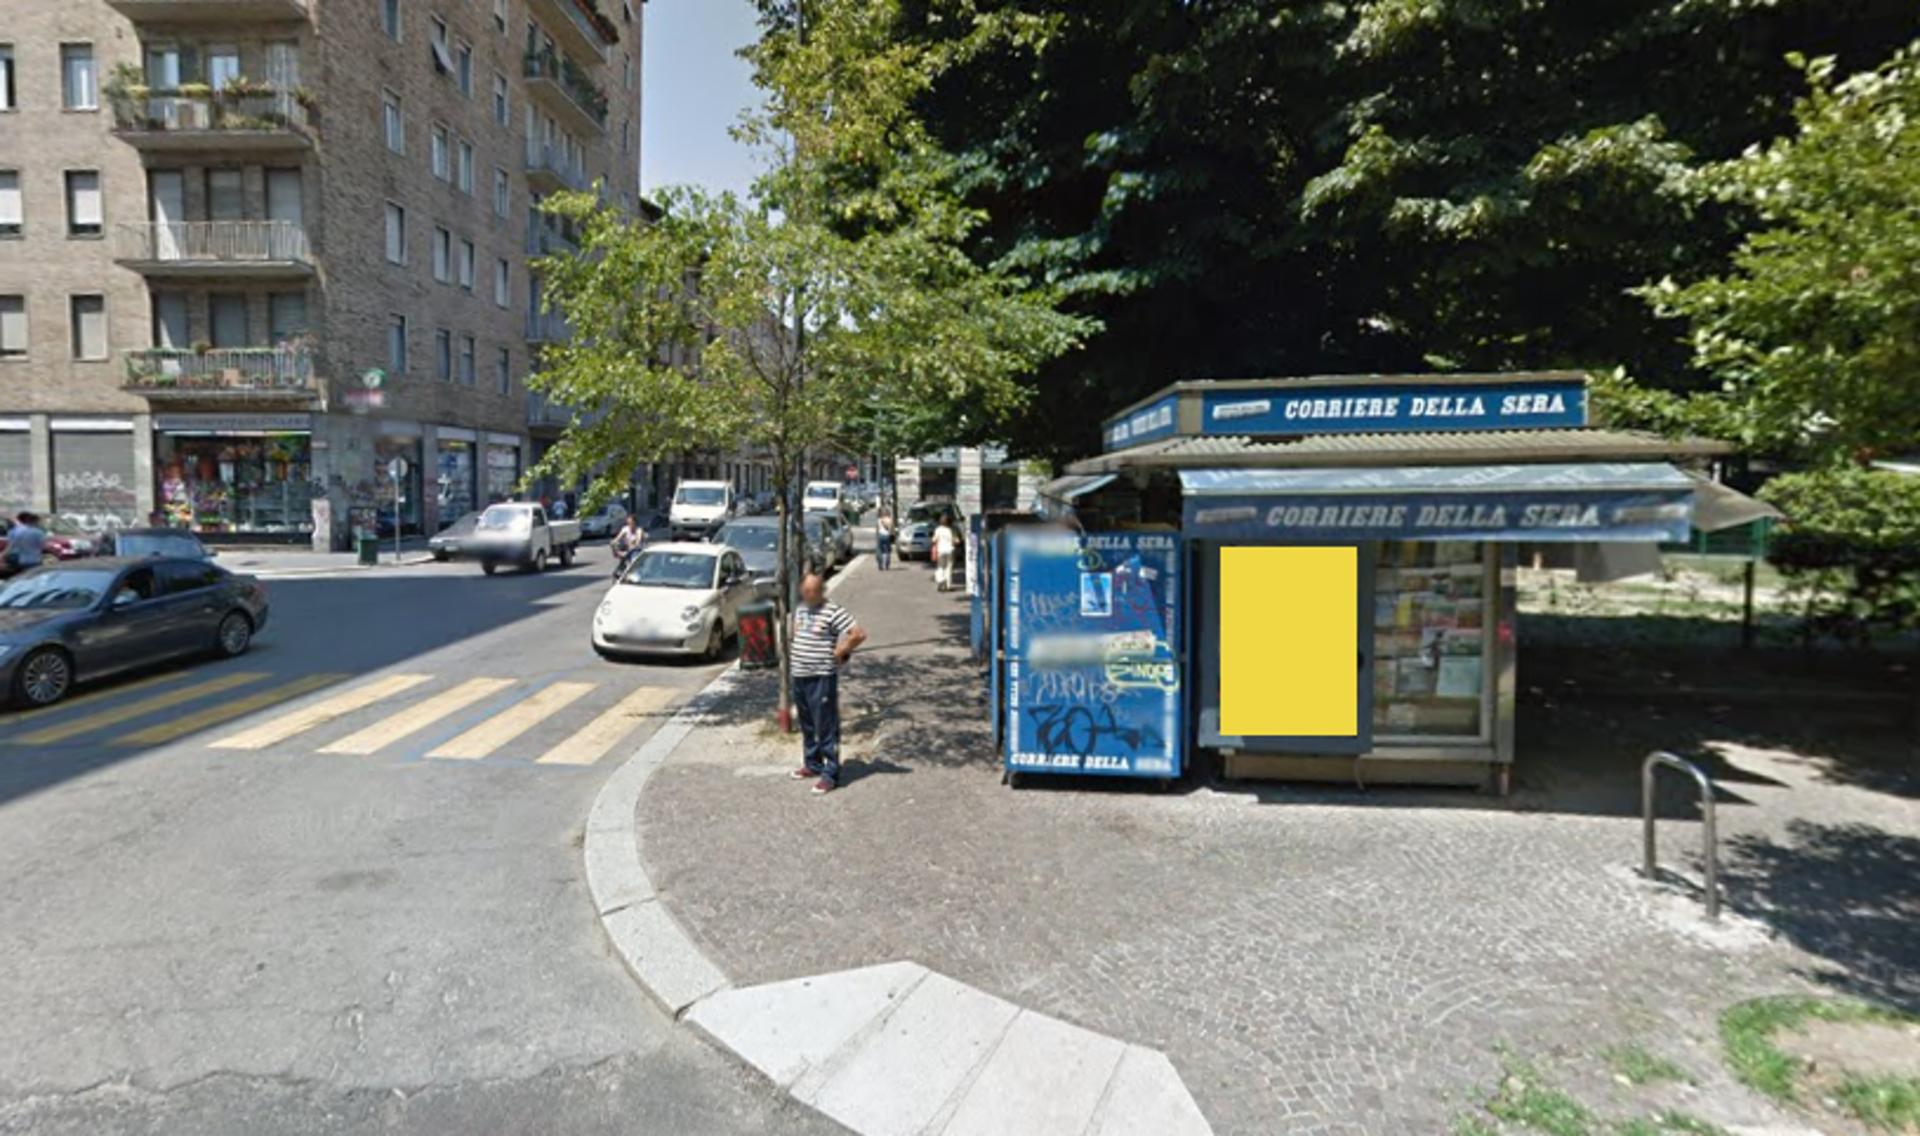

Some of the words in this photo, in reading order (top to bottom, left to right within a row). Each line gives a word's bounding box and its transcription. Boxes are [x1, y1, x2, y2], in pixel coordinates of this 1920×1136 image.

[1284, 398, 1399, 420] CORRIERE
[1409, 397, 1485, 416] DELLA
[1500, 394, 1566, 415] SERA
[1266, 506, 1406, 528] CORRIERE
[1415, 506, 1507, 527] DELLA
[1520, 505, 1600, 527] SERA
[1086, 536, 1132, 550] DELLA
[1136, 536, 1175, 549] SERA
[1083, 755, 1130, 770] DELLA
